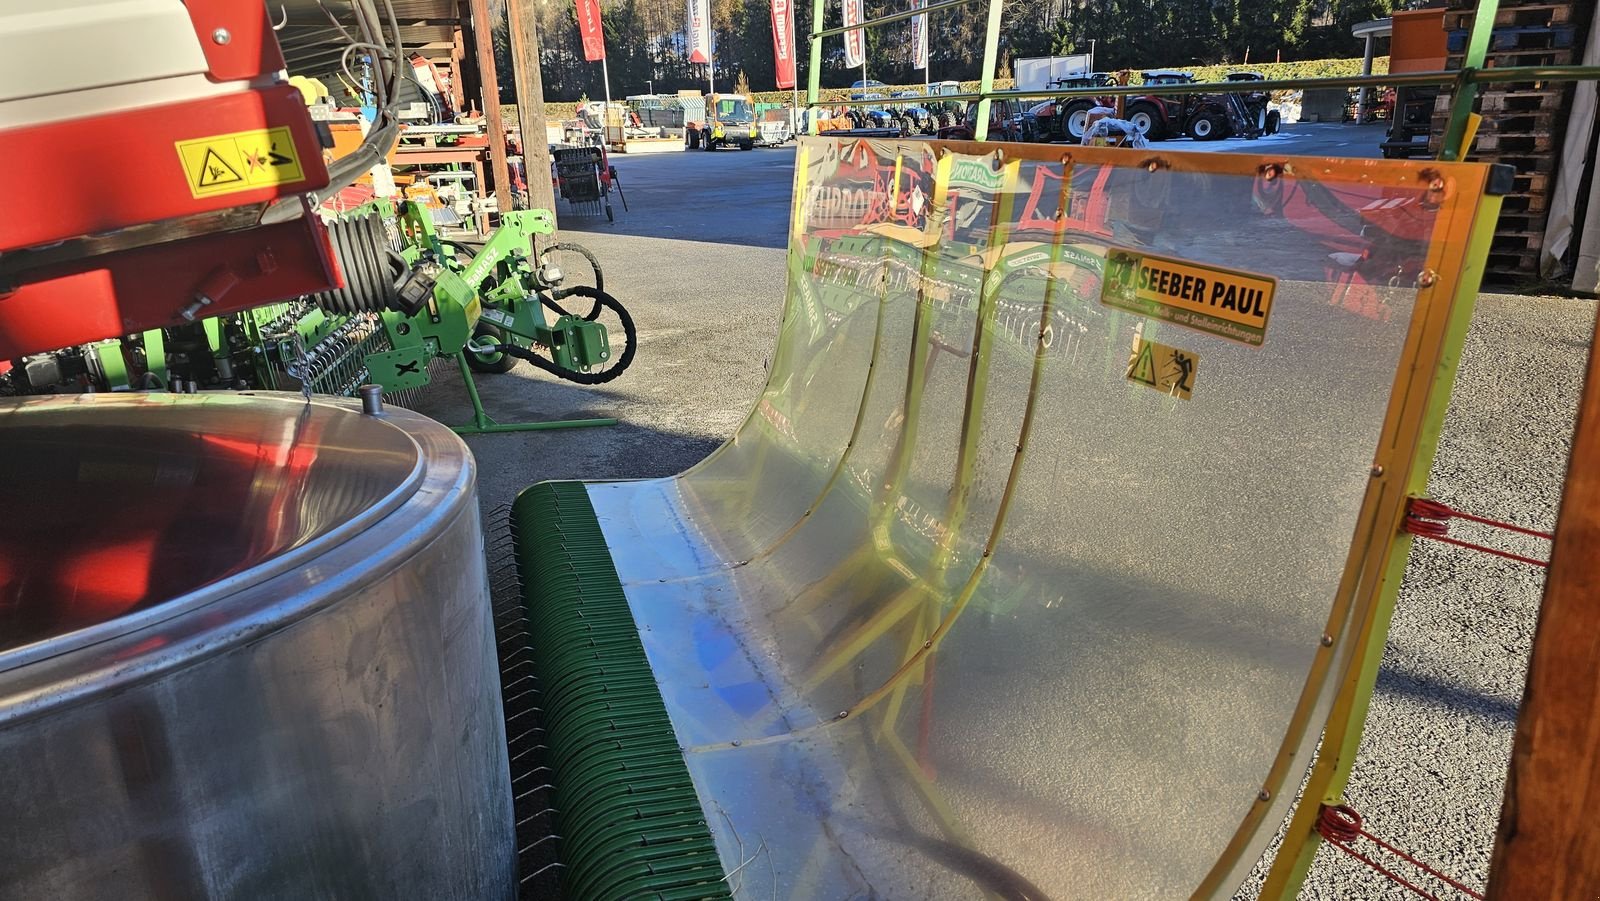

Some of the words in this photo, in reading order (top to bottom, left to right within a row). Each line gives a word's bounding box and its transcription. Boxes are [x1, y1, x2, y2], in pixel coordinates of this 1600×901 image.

[467, 248, 500, 287] SaMASZ
[1139, 265, 1205, 303] SEEBER
[1210, 281, 1265, 316] PAUL
[1175, 311, 1189, 323] und
[1190, 313, 1262, 342] Stalleinrichtungen
